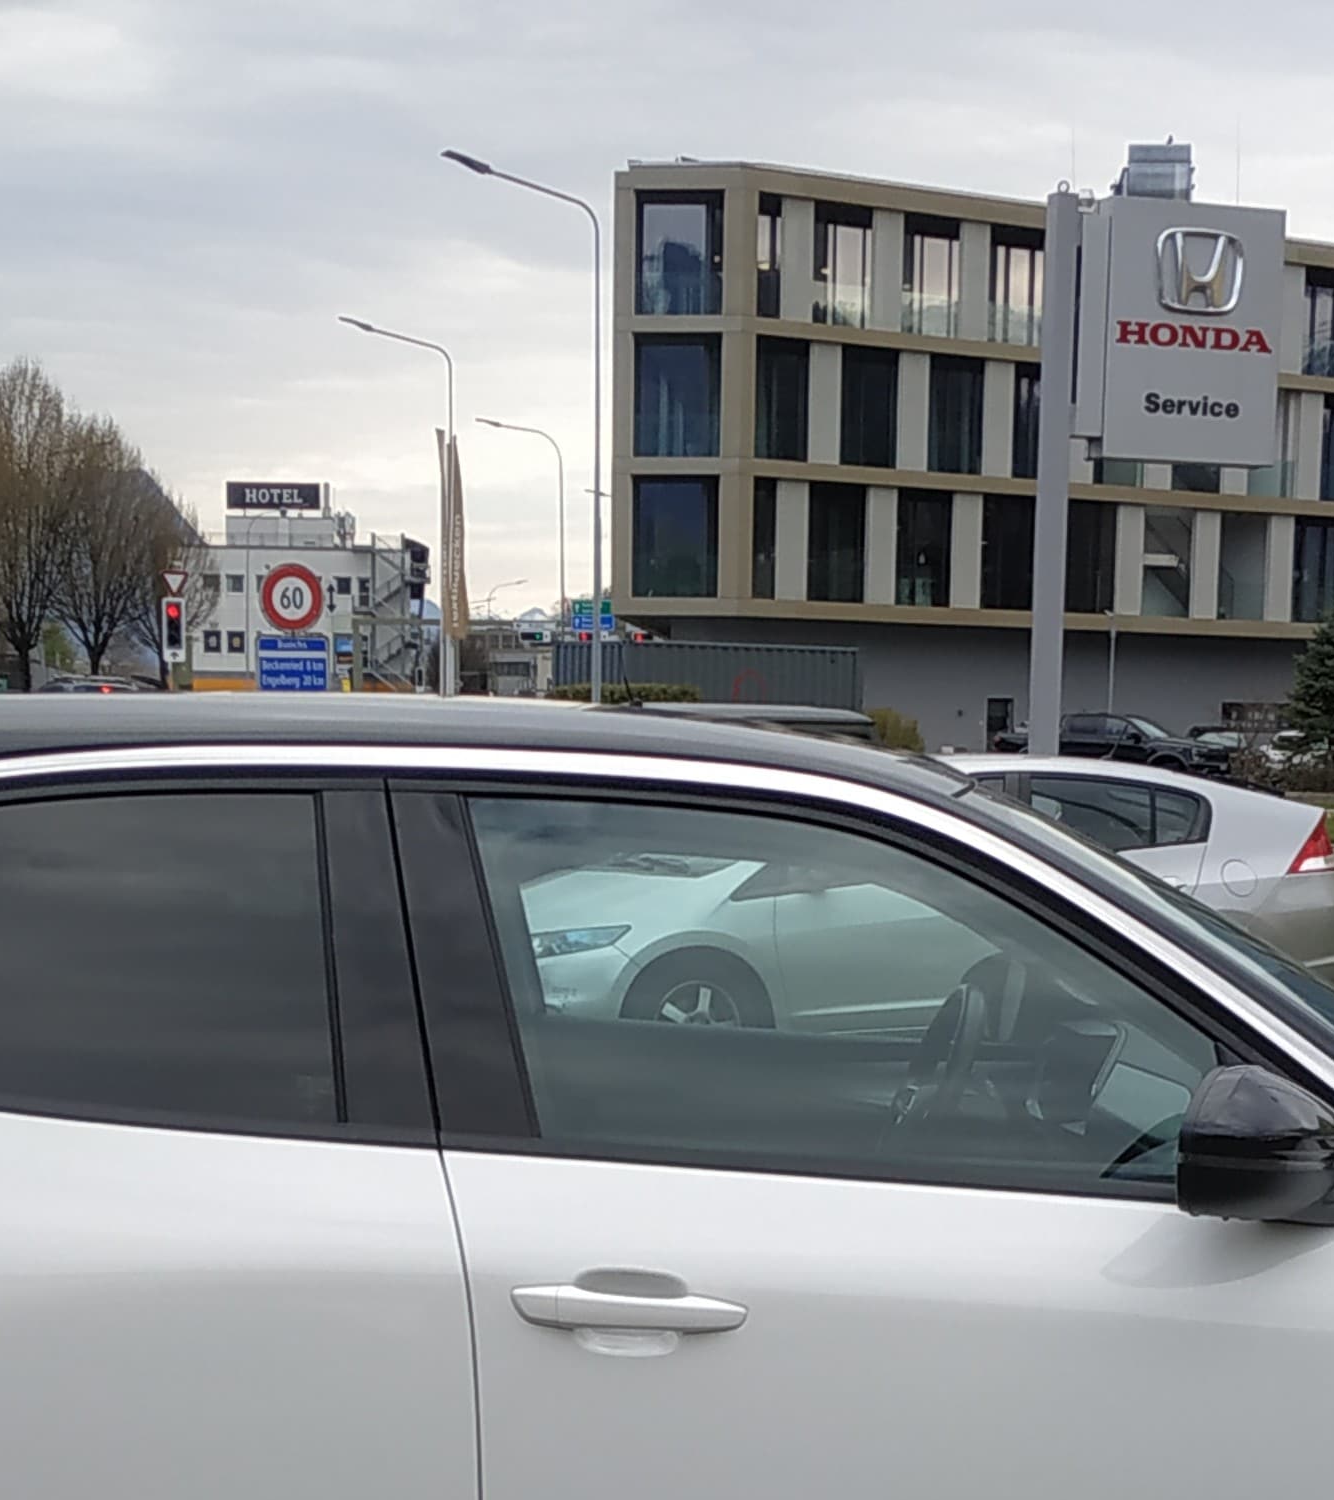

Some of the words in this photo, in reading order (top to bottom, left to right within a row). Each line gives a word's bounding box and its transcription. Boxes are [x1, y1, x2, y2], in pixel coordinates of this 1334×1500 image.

[1116, 320, 1272, 354] HONDA
[1144, 392, 1240, 418] Service
[244, 487, 304, 504] HOTEL
[279, 586, 304, 610] 60
